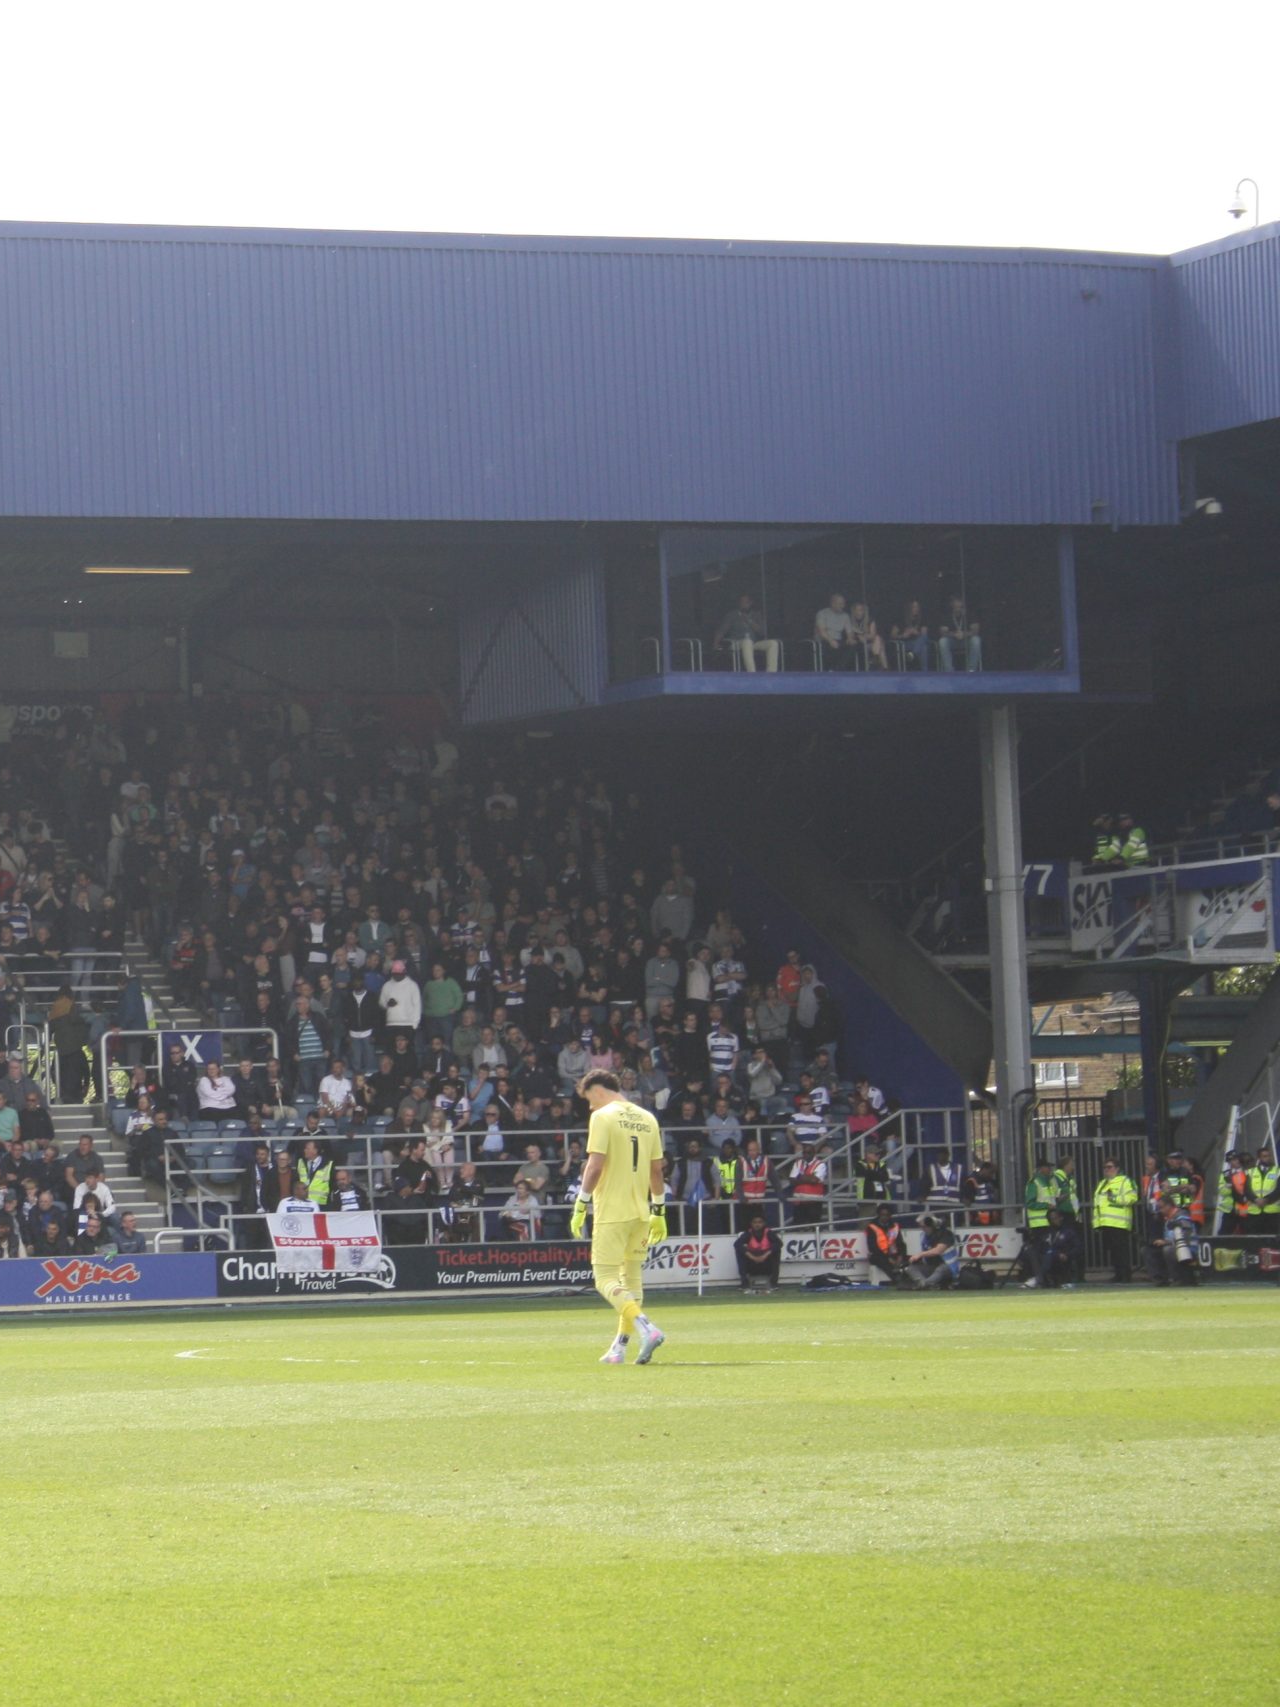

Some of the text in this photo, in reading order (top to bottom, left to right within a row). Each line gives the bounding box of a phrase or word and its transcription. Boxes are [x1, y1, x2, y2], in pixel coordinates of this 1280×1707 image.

[181, 1035, 204, 1063] X
[631, 1136, 639, 1172] 1
[278, 1237, 372, 1246] Stevenage R's
[34, 1259, 141, 1298] Xtra
[300, 1278, 336, 1290] Travel
[437, 1271, 464, 1284] Your
[466, 1269, 520, 1283] Premium
[523, 1268, 557, 1282] Event
[45, 1293, 131, 1304] MAINTENANCE
